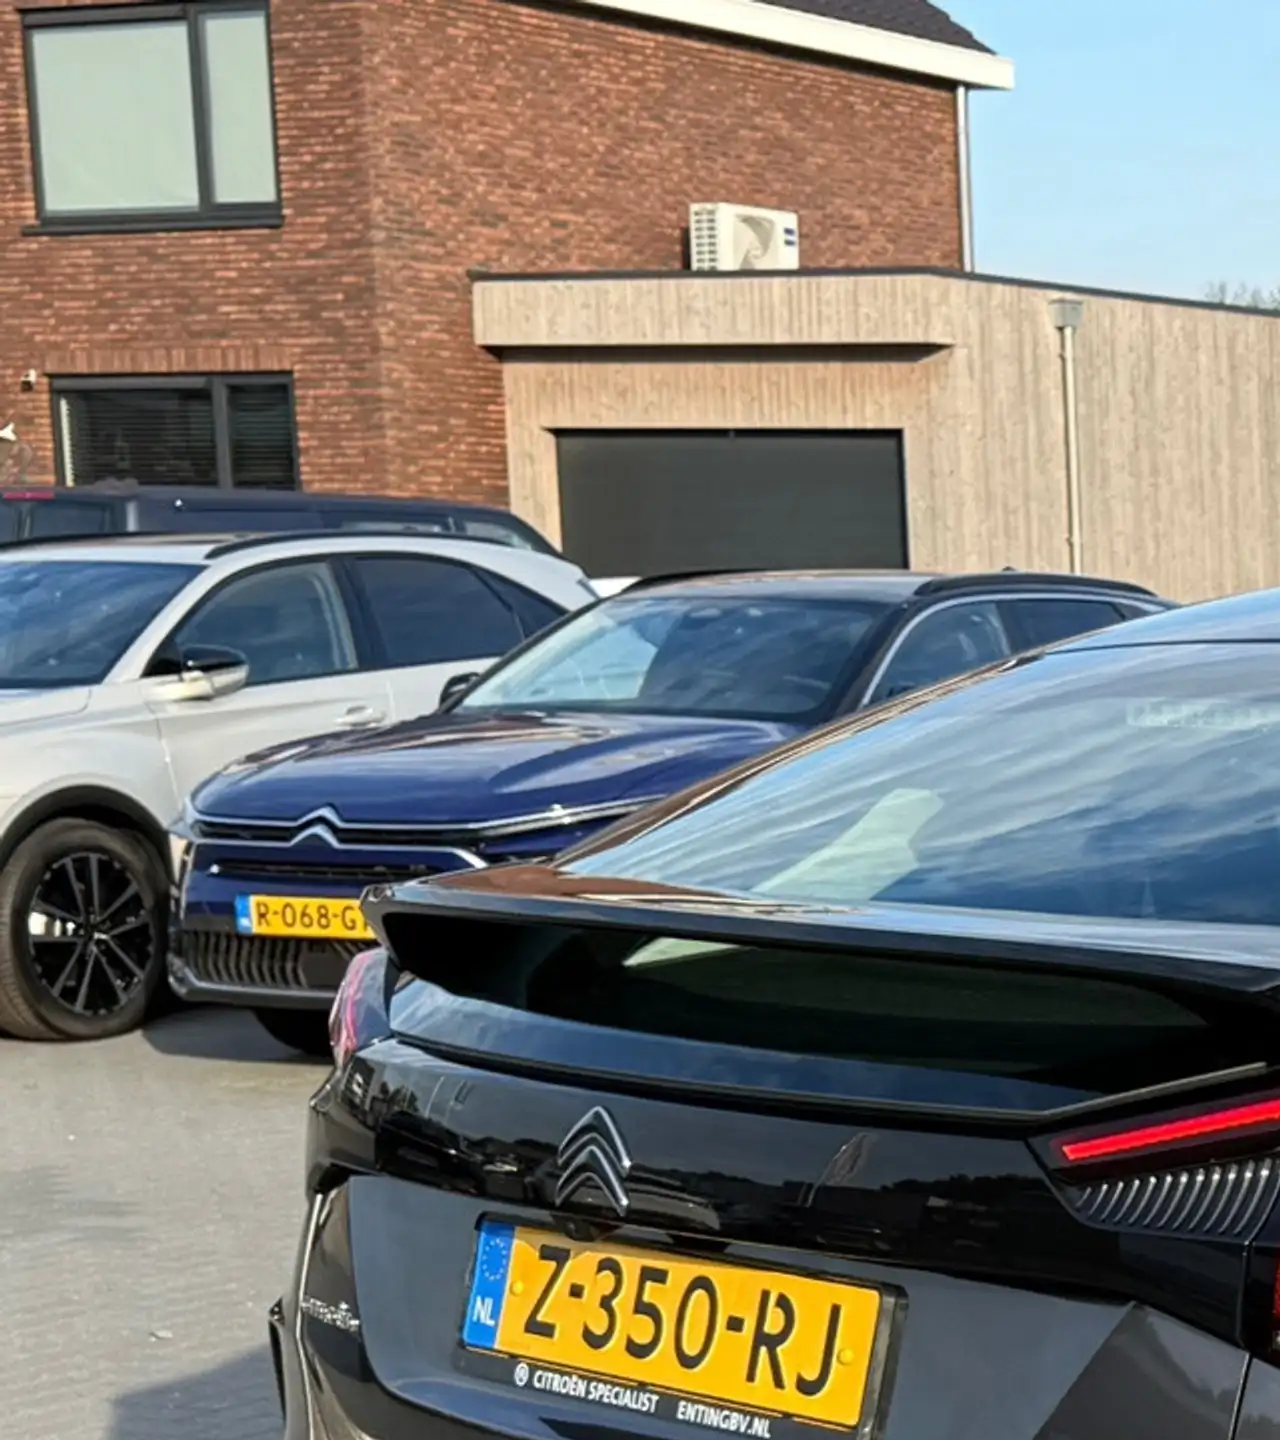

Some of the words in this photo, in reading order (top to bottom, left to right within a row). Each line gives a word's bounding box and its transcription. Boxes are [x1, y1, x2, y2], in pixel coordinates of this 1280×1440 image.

[255, 900, 369, 932] R-068-G
[473, 1295, 496, 1327] NL
[523, 1243, 843, 1397] Z-350-RJ
[587, 1382, 660, 1414] SPECIALIST
[675, 1399, 772, 1439] ENTINGBV.NL
